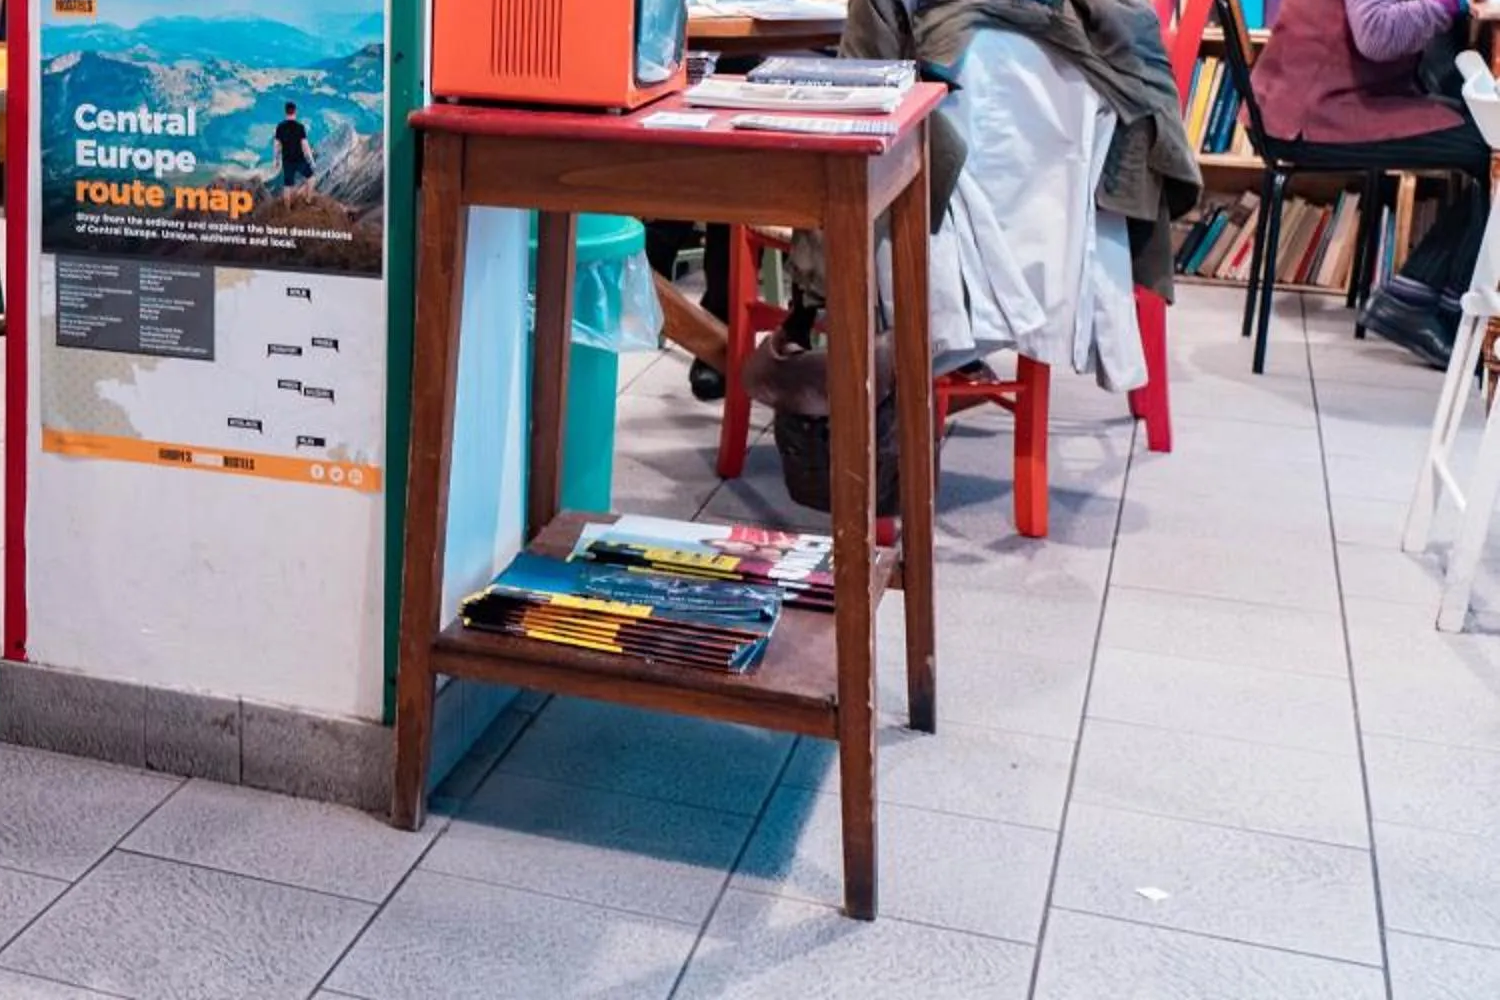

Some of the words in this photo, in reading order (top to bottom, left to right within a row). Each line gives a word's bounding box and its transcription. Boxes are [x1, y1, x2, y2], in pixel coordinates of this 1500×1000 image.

[74, 103, 196, 137] Central
[75, 138, 197, 178] Europe
[74, 179, 165, 209] route
[175, 185, 254, 219] map
[75, 223, 86, 233] of
[87, 224, 121, 236] Central
[249, 236, 268, 247] and
[127, 215, 143, 225] the
[187, 220, 207, 230] and
[247, 223, 264, 234] the
[265, 224, 287, 235] best
[289, 226, 353, 241] destinations
